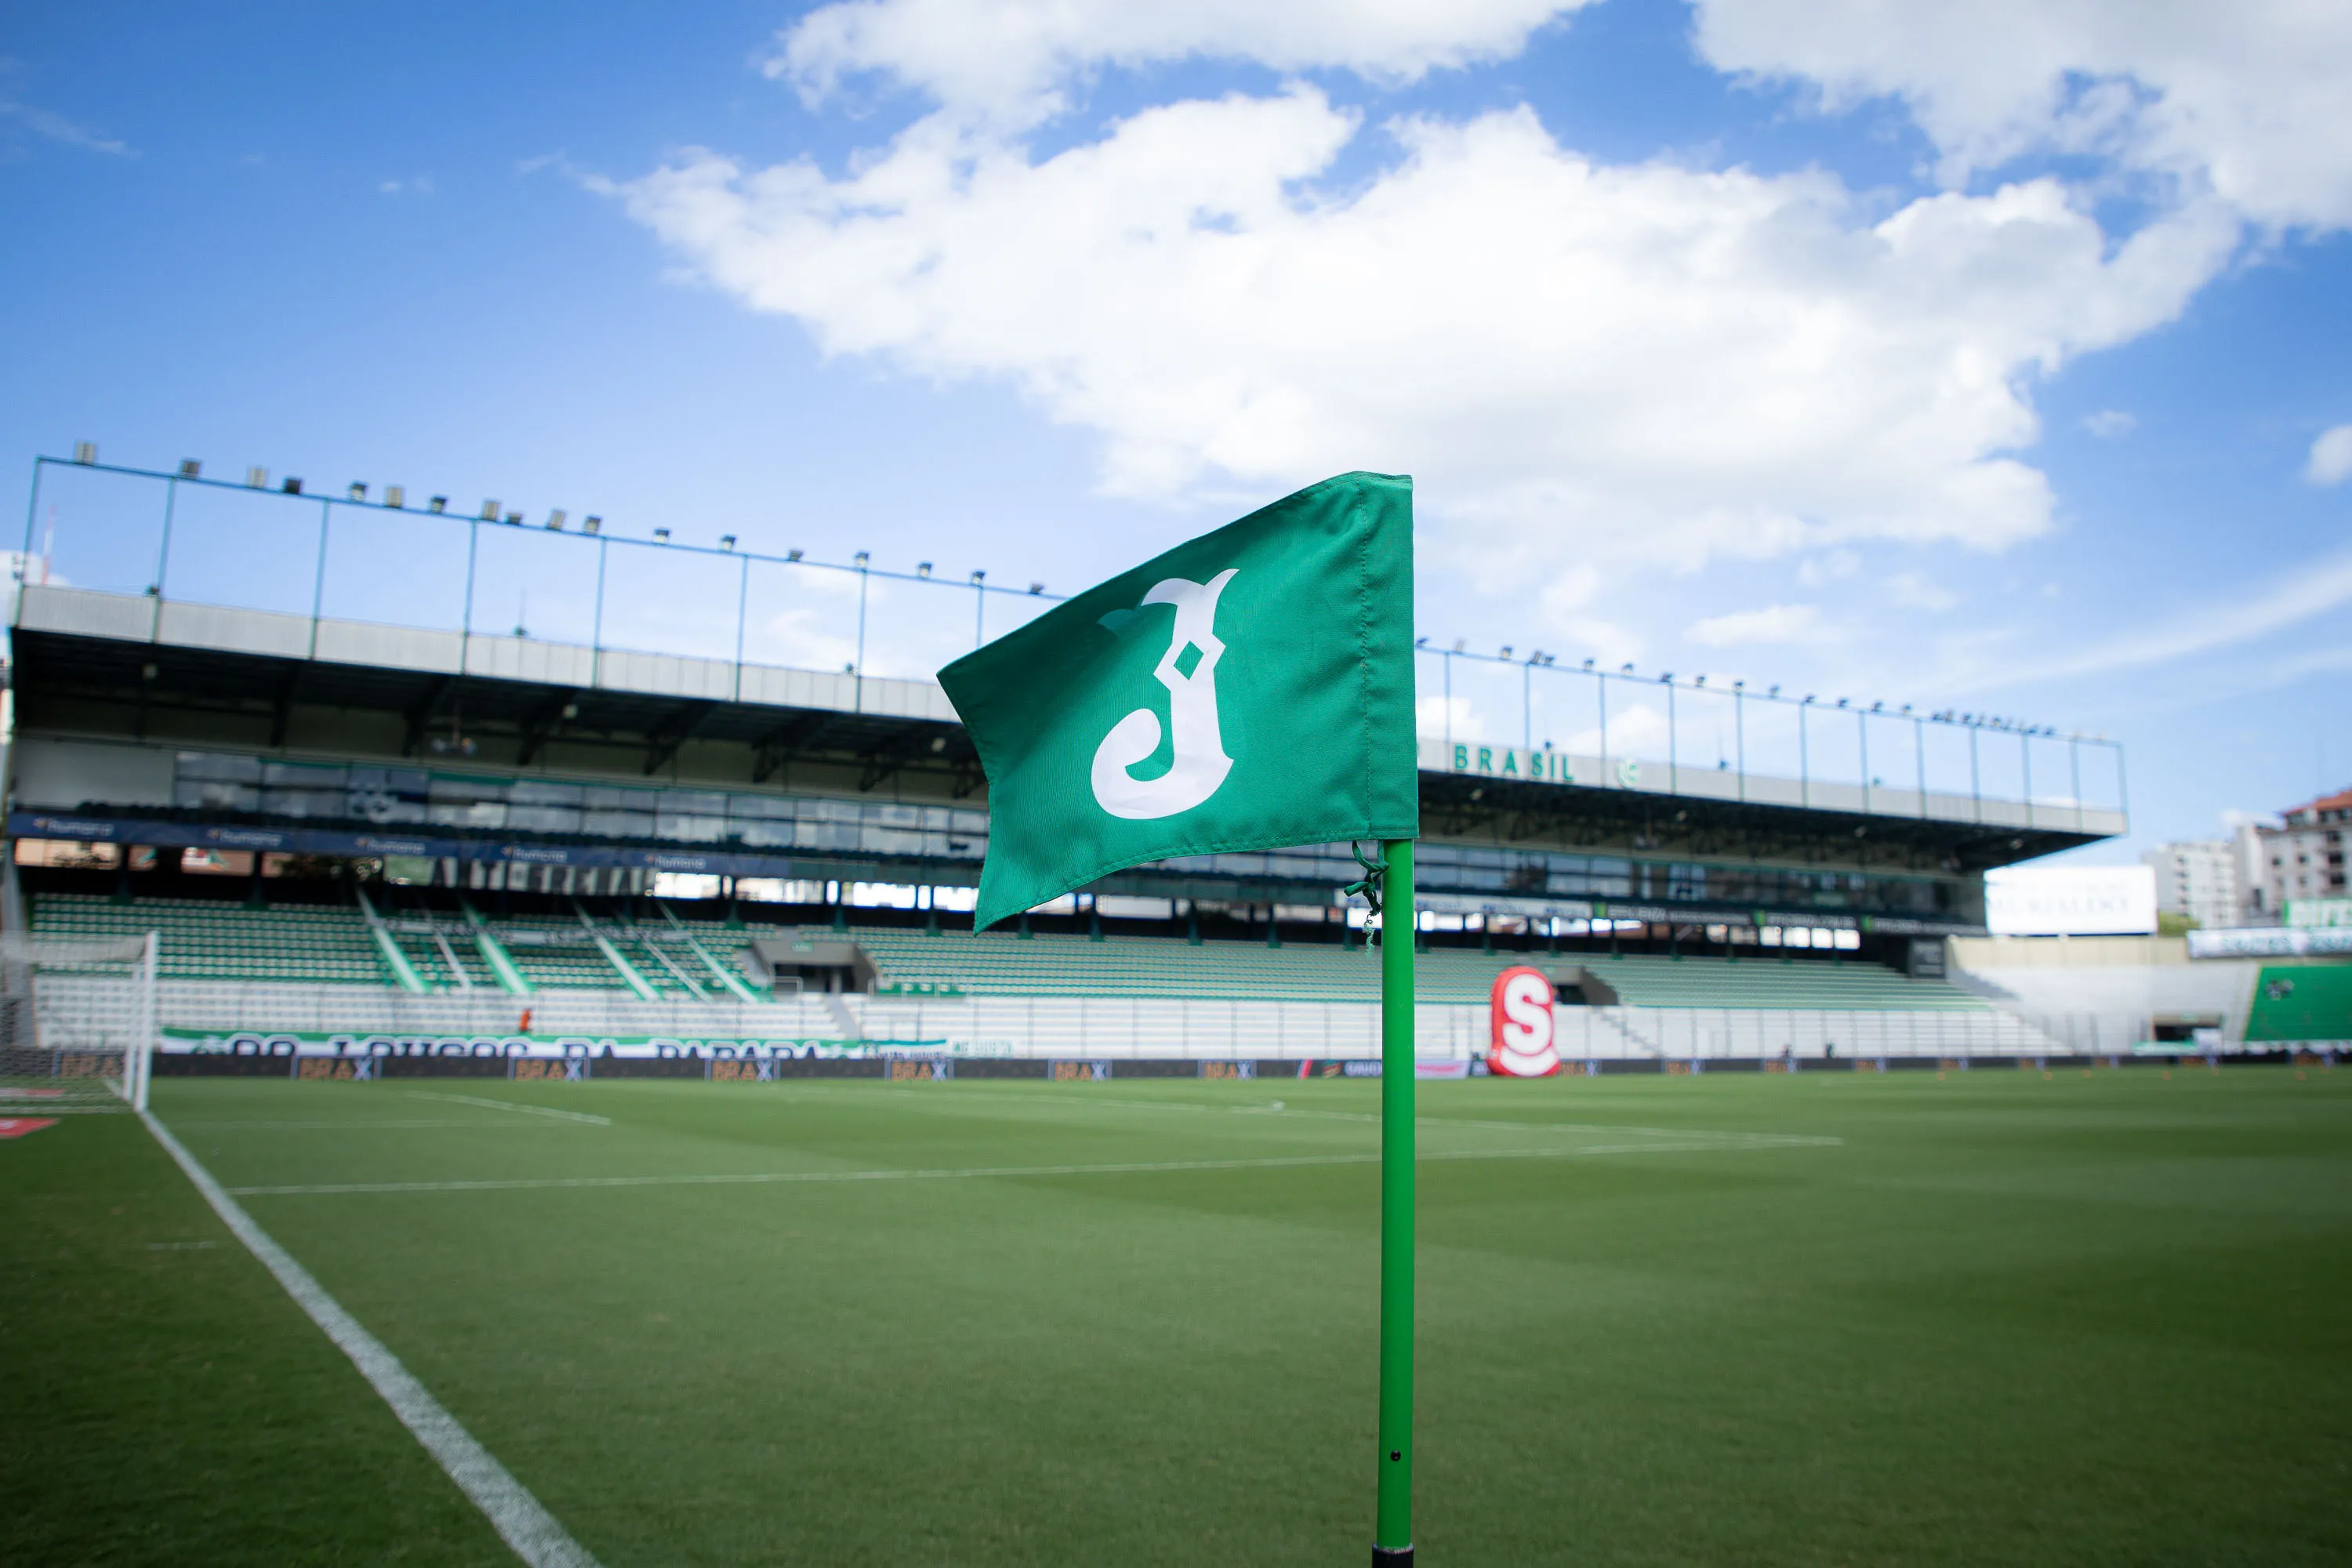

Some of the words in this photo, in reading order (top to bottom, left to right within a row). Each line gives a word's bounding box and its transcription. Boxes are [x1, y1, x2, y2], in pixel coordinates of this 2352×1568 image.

[1091, 568, 1240, 819] J
[1454, 742, 1574, 781] BRASIL
[1502, 974, 1553, 1055] S
[298, 1058, 372, 1080] BRAX
[514, 1059, 582, 1081] BRAX
[713, 1061, 773, 1082] BRAX
[891, 1061, 946, 1081] BRAX
[1054, 1061, 1105, 1081] BRAX
[1205, 1061, 1252, 1081] BRAX
